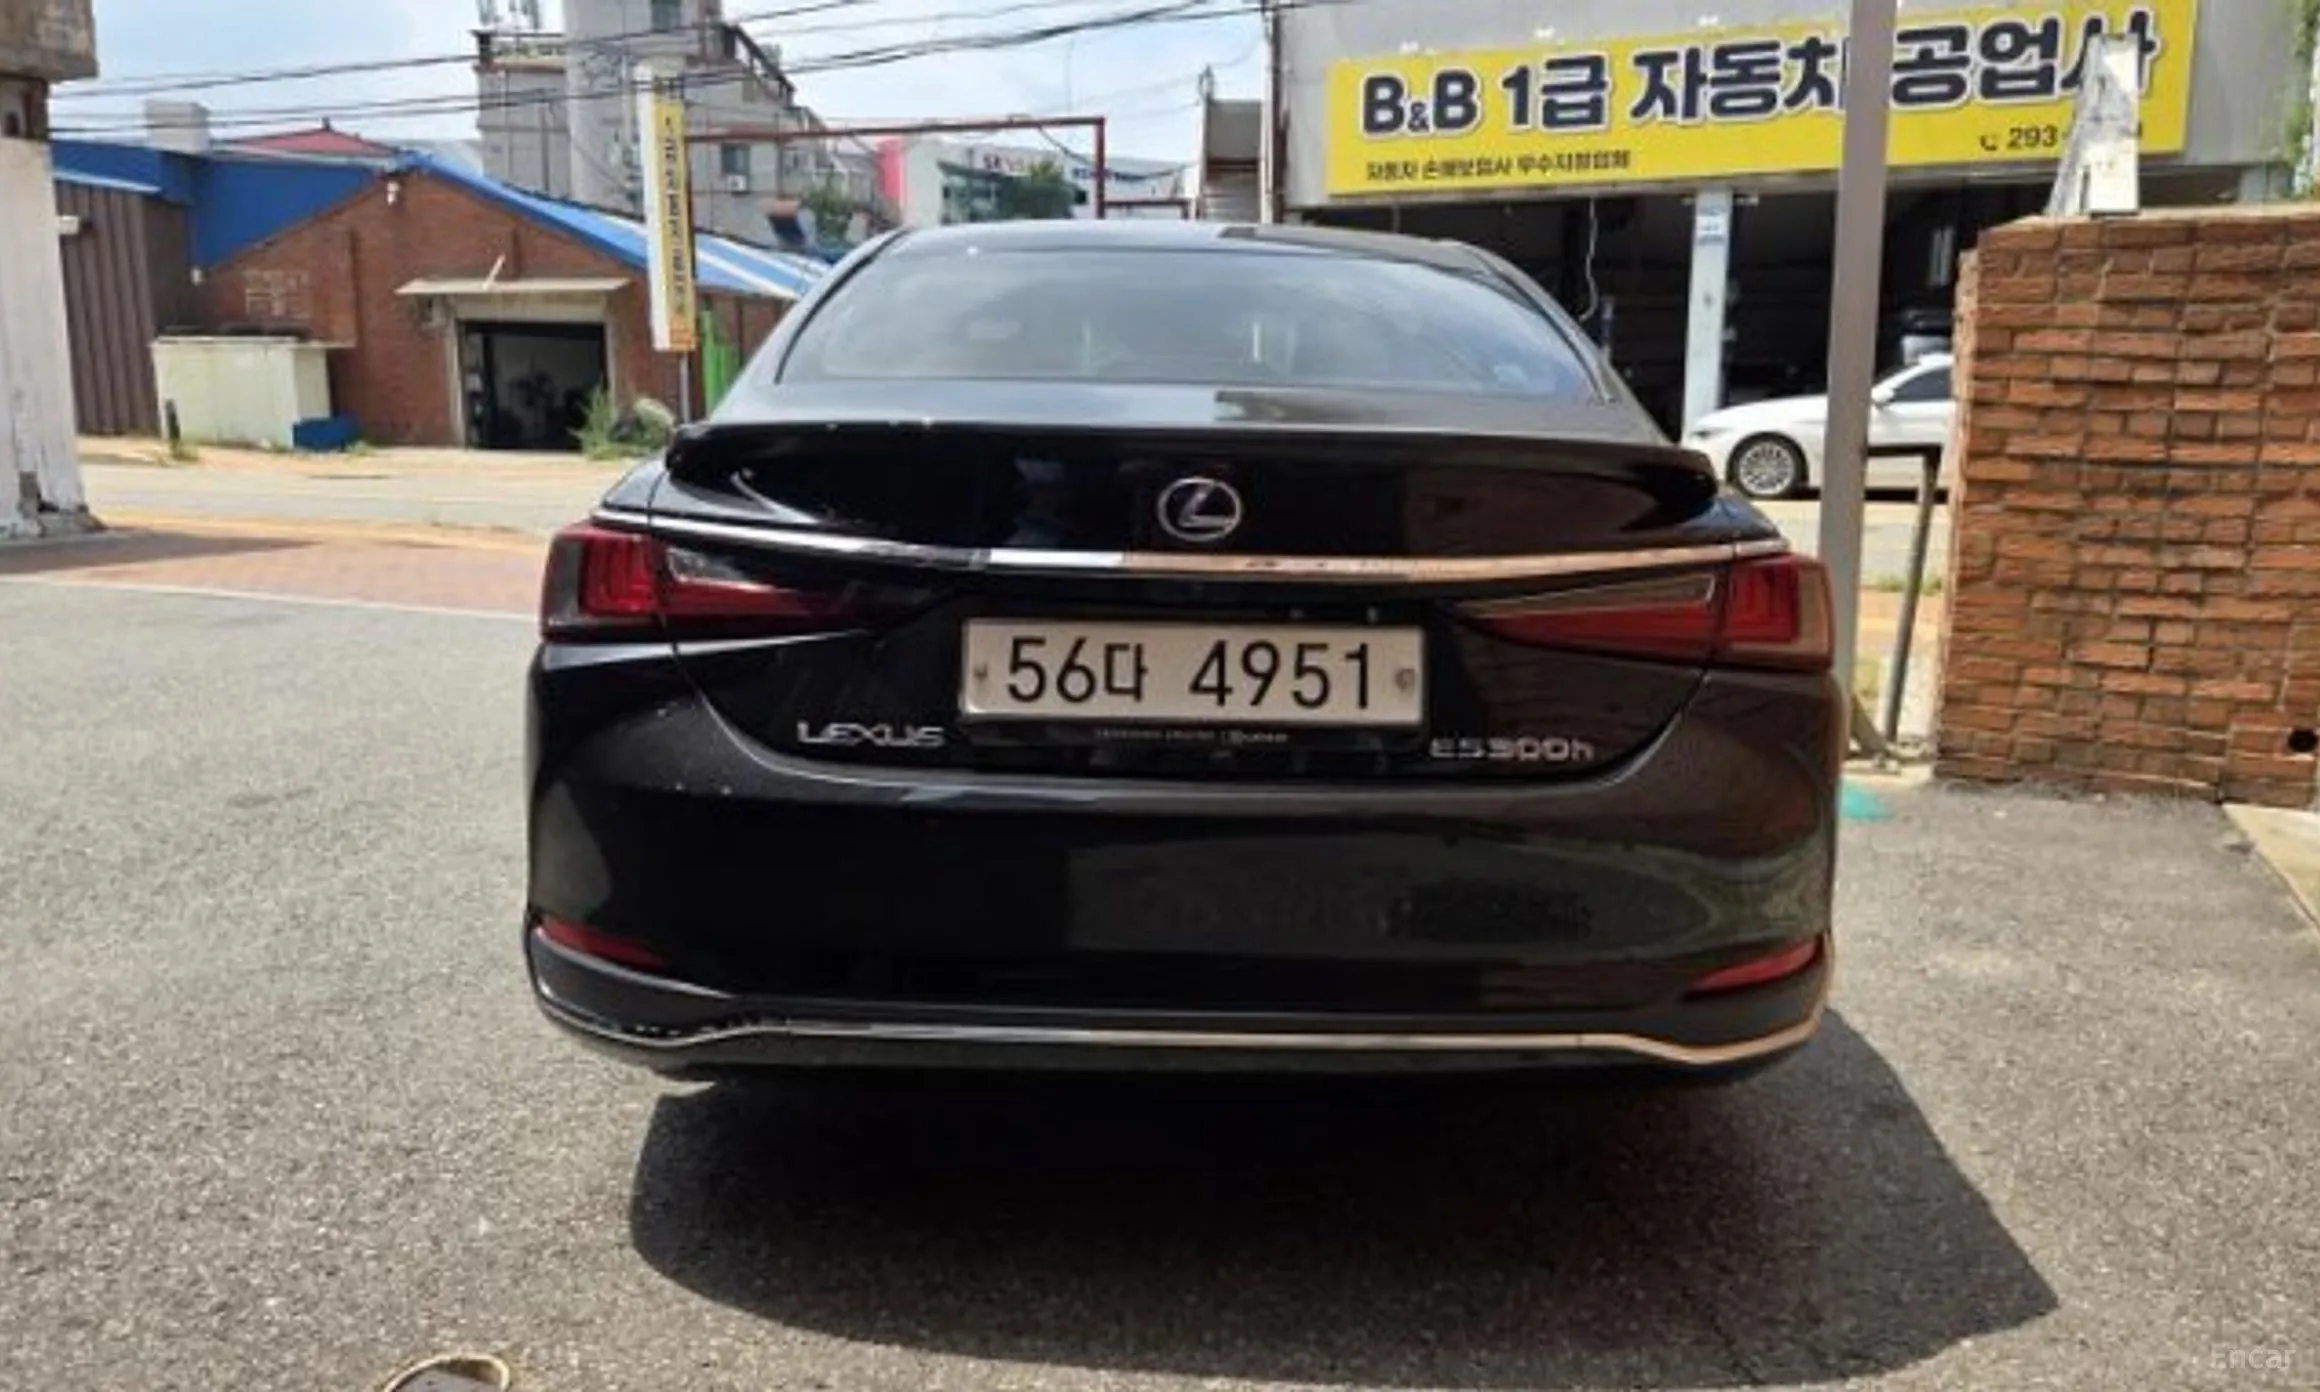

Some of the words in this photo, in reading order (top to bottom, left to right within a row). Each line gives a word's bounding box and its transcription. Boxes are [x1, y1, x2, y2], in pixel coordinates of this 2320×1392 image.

[1362, 69, 1479, 134] B&B
[1502, 55, 1608, 129] 1급
[1006, 635, 1149, 704] 56다
[1188, 638, 1371, 711] 4951
[796, 721, 946, 748] LEXUS
[1429, 736, 1596, 762] ES300h
